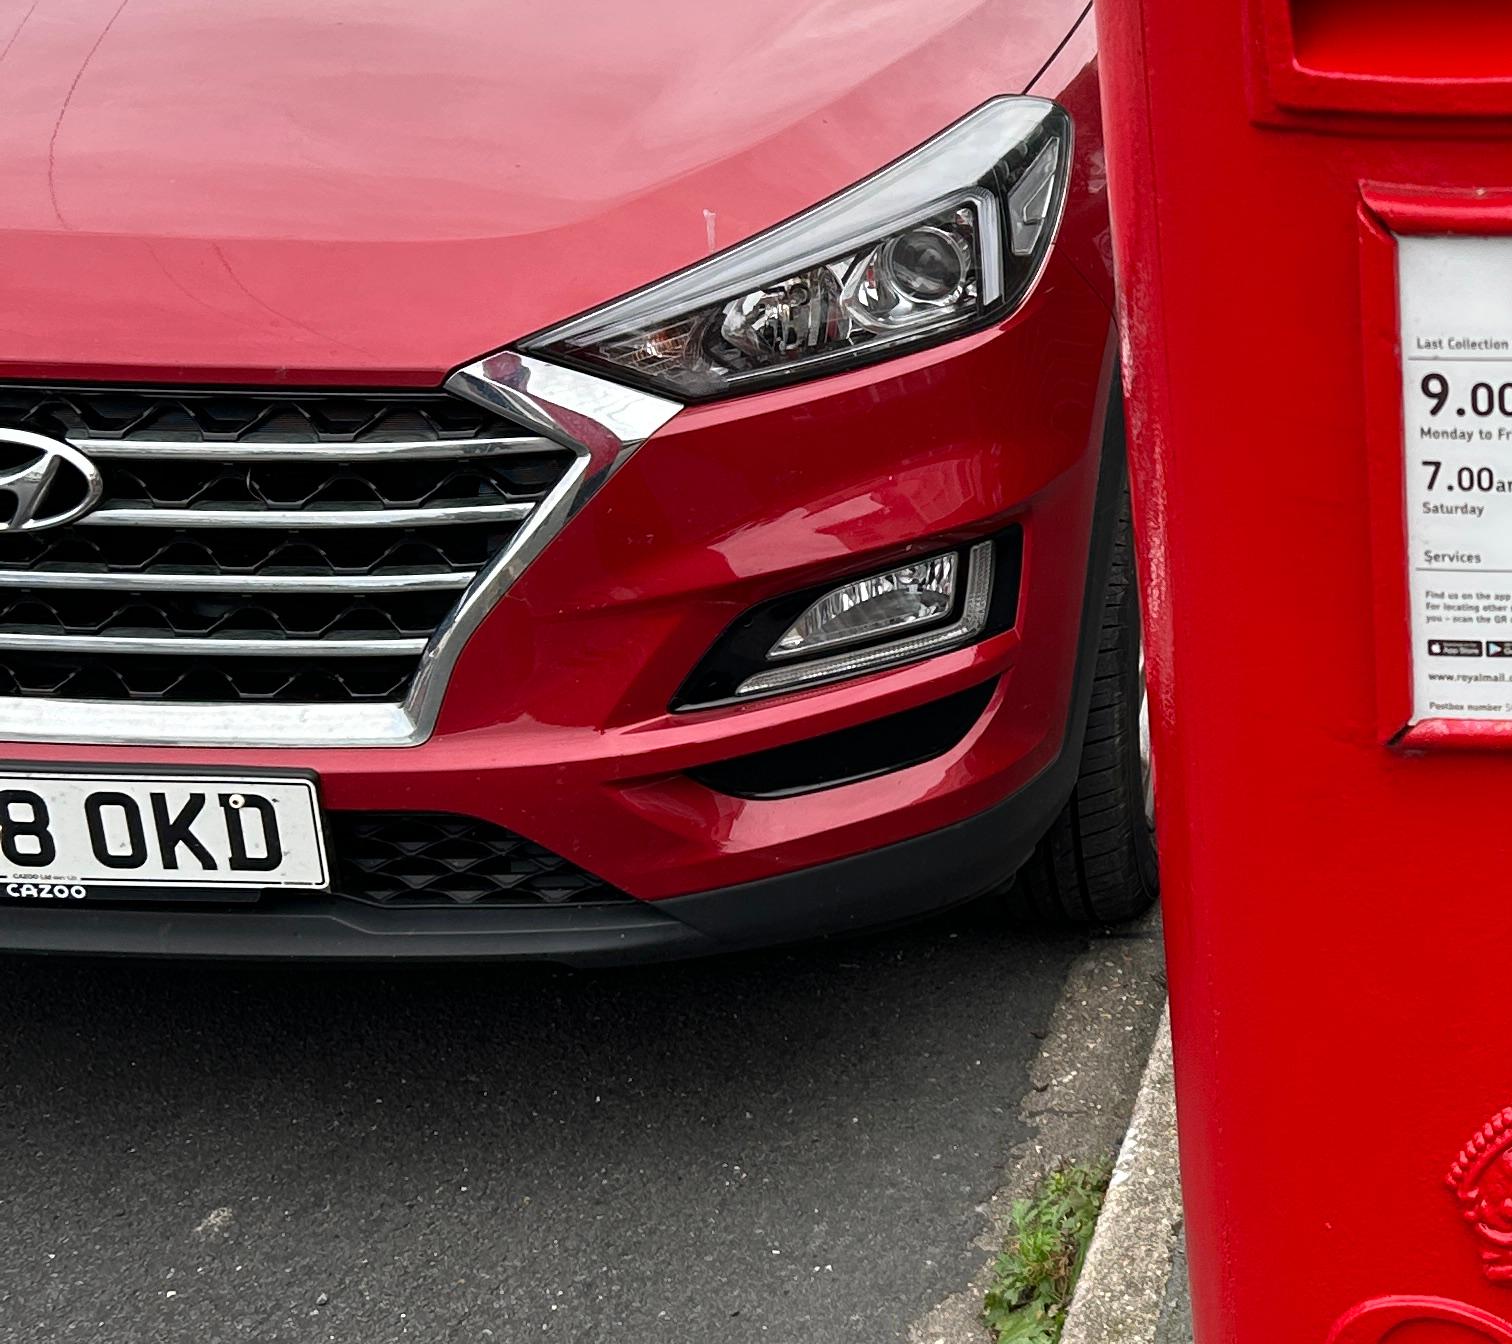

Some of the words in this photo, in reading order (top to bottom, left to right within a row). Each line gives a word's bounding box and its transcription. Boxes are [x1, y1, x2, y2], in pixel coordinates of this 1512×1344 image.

[1416, 337, 1444, 350] Last
[1448, 337, 1509, 350] Collection
[1420, 427, 1474, 442] Monday
[1478, 428, 1493, 441] to
[1422, 502, 1485, 517] Saturday
[1424, 550, 1482, 564] Services
[1425, 591, 1445, 599] Find
[1476, 592, 1491, 600] the
[1494, 593, 1511, 601] app
[1425, 602, 1441, 610] for
[1443, 603, 1480, 613] locating
[1482, 604, 1508, 612] other
[1426, 615, 1443, 624] you
[1476, 615, 1491, 623] the
[1429, 701, 1465, 711] Postbox
[1467, 702, 1503, 712] number
[84, 791, 283, 871] OKD
[6, 883, 87, 899] CAZOO
